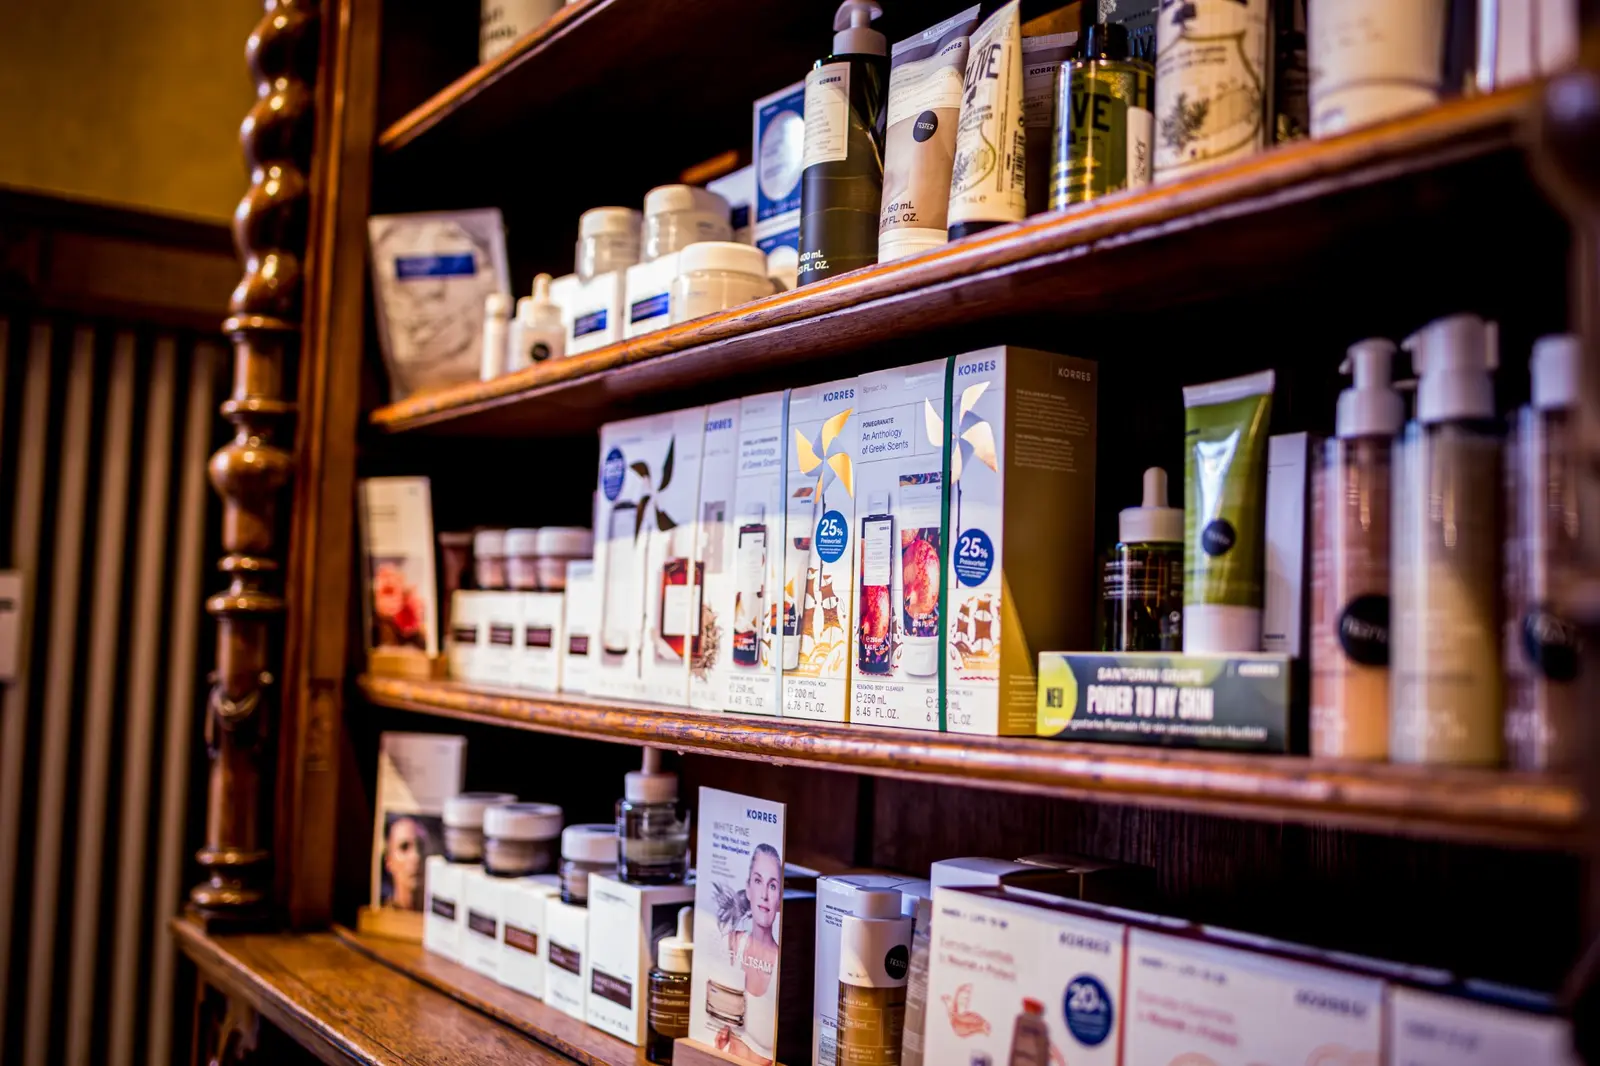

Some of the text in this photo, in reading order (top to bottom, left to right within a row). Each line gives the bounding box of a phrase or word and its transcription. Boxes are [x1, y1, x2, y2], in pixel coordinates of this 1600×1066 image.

[916, 120, 935, 131] TESTER
[900, 200, 914, 210] mL
[902, 213, 919, 222] OZ.
[811, 250, 824, 259] mL
[815, 261, 829, 270] OZ.
[958, 360, 996, 376] KORRES
[1057, 367, 1091, 382] KORRES
[823, 389, 855, 402] KORRES
[862, 417, 894, 428] POMEGRANATE
[862, 429, 903, 441] An Anthology
[862, 440, 909, 455] of Greek Scents
[820, 519, 843, 537] 25%
[960, 536, 988, 559] 25%
[1097, 666, 1205, 684] SANTORINI GRAPE
[794, 688, 807, 699] 200
[808, 690, 817, 700] mL
[863, 693, 876, 704] 250
[877, 695, 887, 705] mL
[1046, 687, 1064, 708] NEU
[787, 700, 827, 713] 6.76 FL.OZ.
[1087, 684, 1214, 720] POWER TO MY SKIN
[855, 706, 900, 720] 8.45 FL.OZ.
[926, 711, 939, 723] 6.7
[746, 809, 778, 824] KORRES
[713, 821, 750, 837] WHITE PINE
